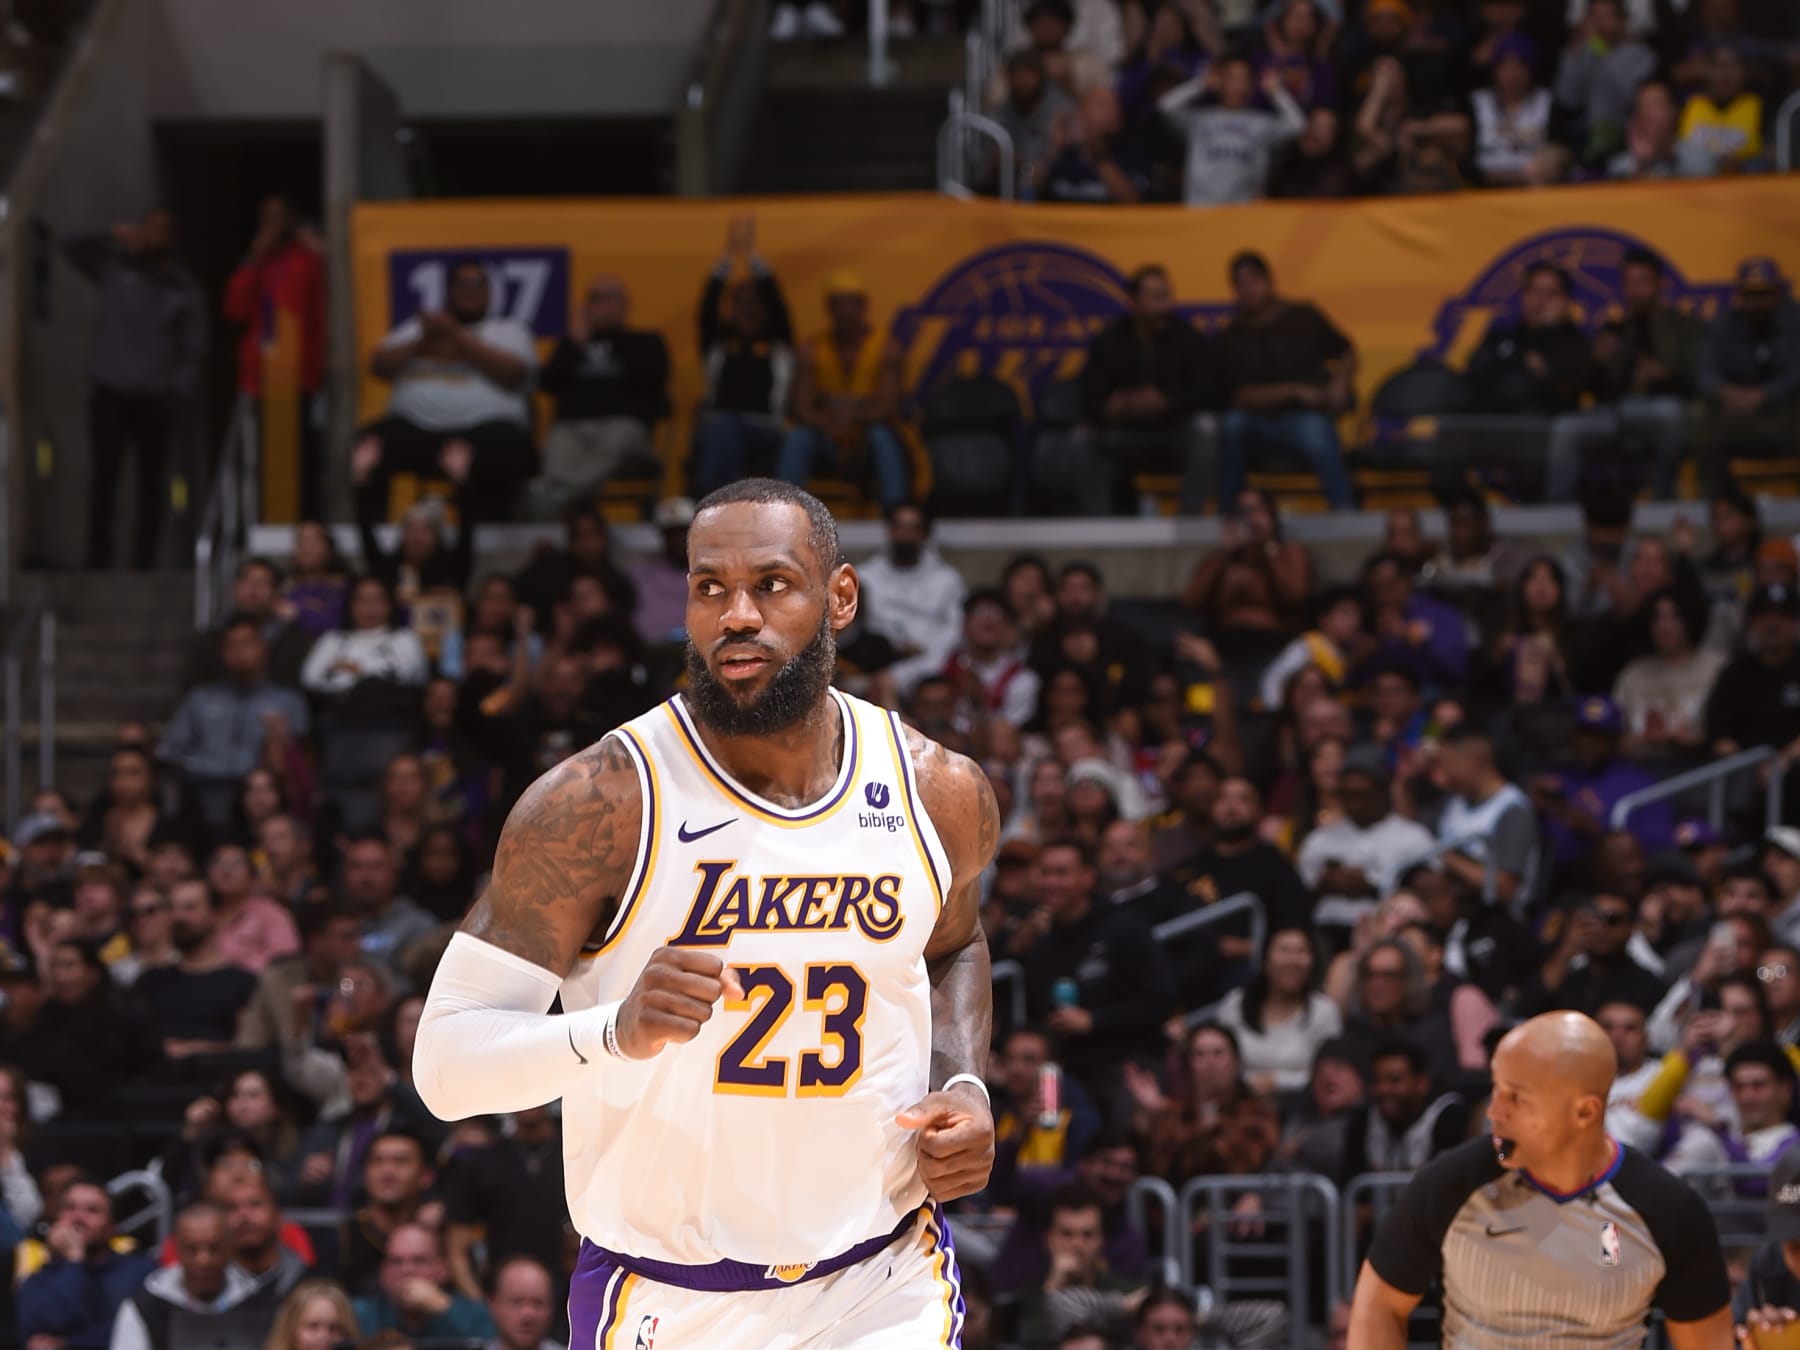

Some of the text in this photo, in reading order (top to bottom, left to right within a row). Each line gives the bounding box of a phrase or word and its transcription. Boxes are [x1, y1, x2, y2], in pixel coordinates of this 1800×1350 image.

[407, 258, 553, 324] 17
[858, 812, 905, 832] bibigo
[664, 859, 907, 947] LAKERS
[608, 1030, 627, 1061] PROM
[712, 960, 871, 1099] 23
